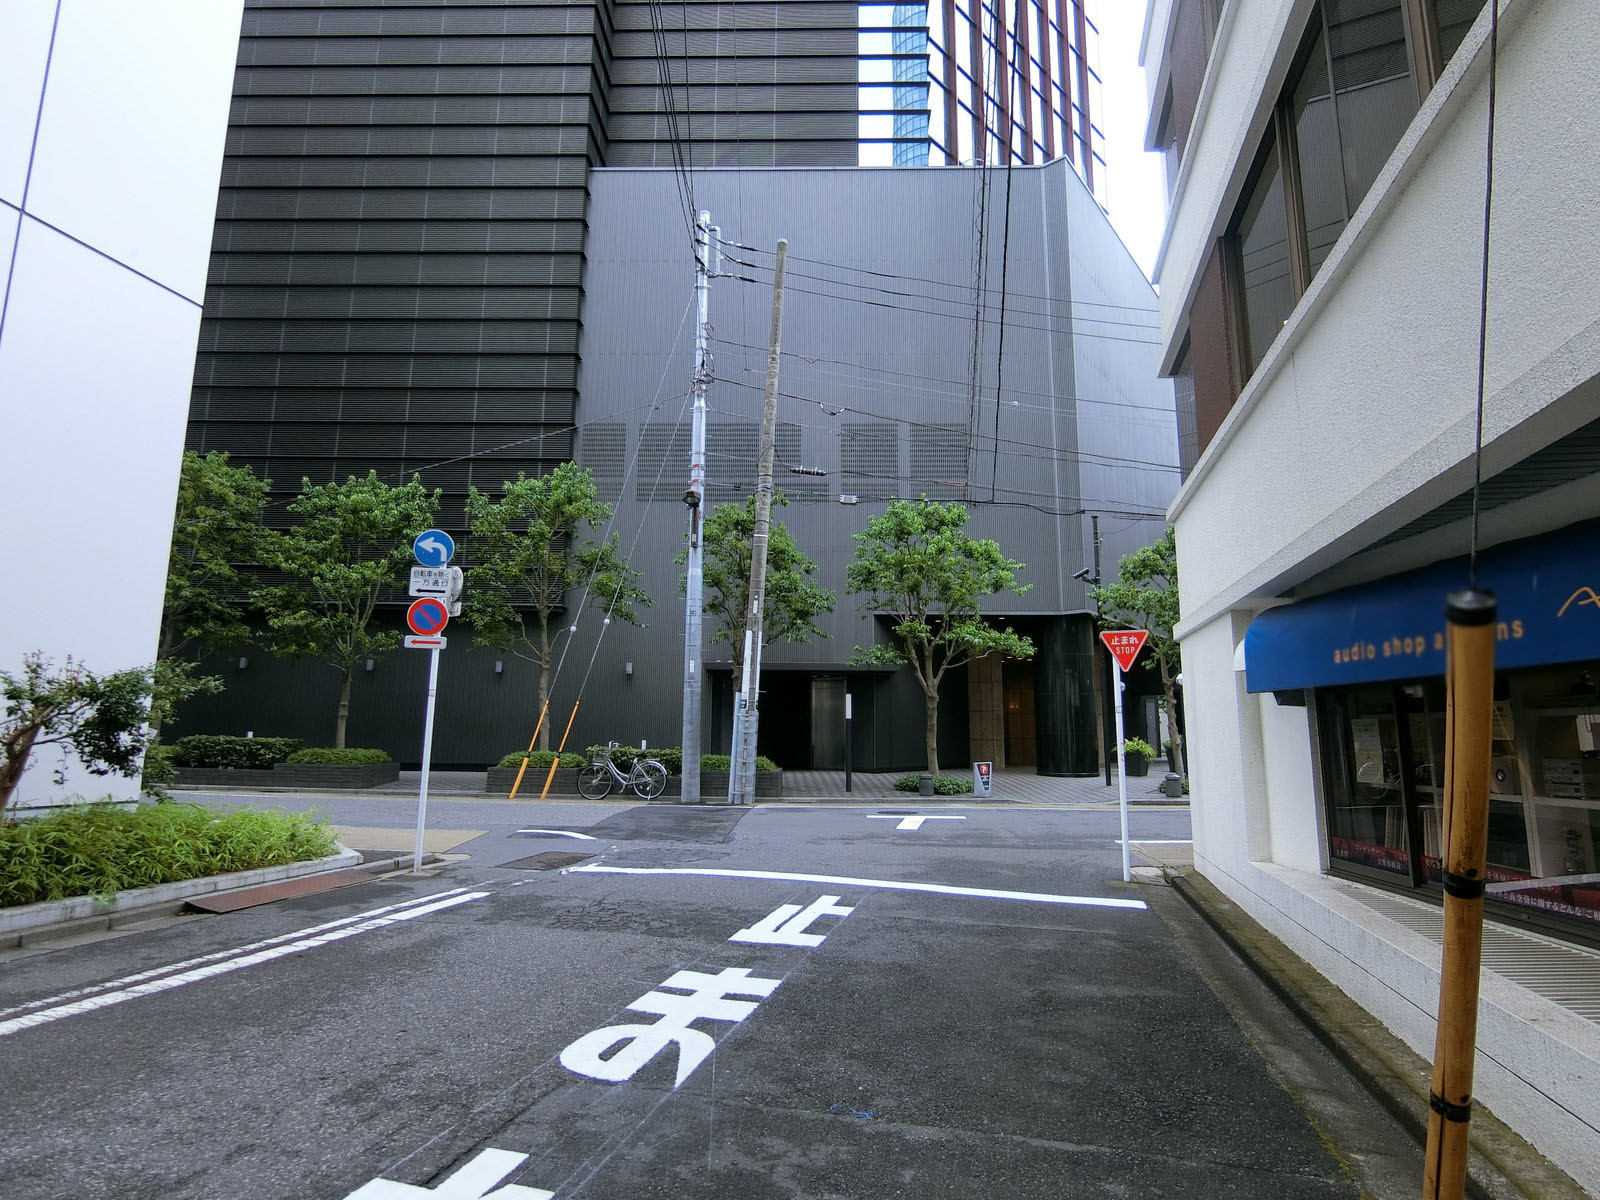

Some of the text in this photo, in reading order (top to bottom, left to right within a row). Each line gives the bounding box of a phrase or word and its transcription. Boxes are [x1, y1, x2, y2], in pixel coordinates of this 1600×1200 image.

[413, 579, 449, 588] 一方通行
[1111, 635, 1139, 645] 止まれ
[1115, 646, 1136, 655] STOP
[1334, 635, 1426, 664] audio shop
